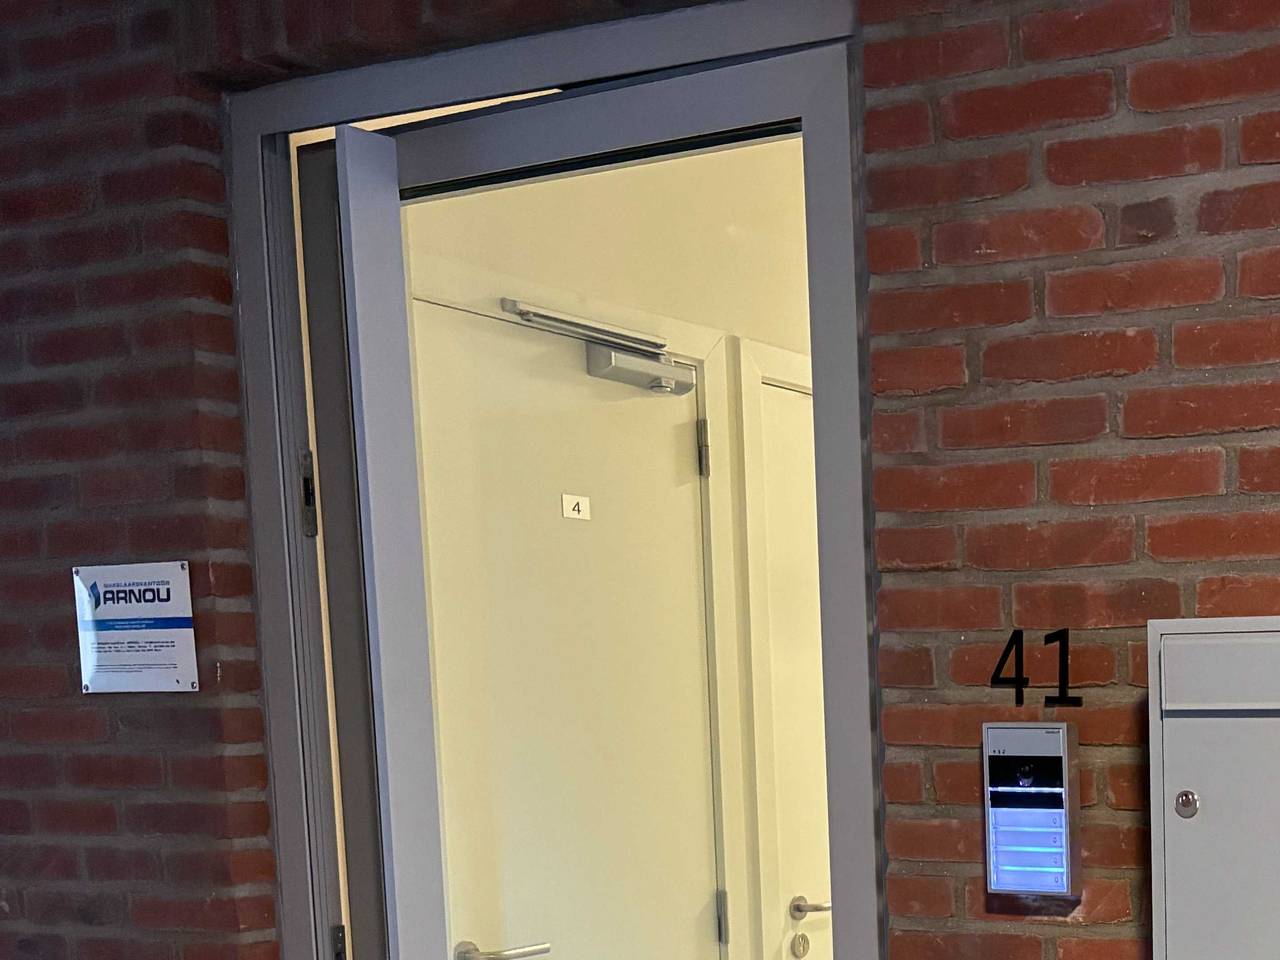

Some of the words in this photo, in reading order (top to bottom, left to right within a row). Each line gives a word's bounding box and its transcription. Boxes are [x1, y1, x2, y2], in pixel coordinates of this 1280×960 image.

[571, 500, 582, 515] 4
[103, 587, 171, 605] ARNOU
[990, 627, 1083, 708] 41
